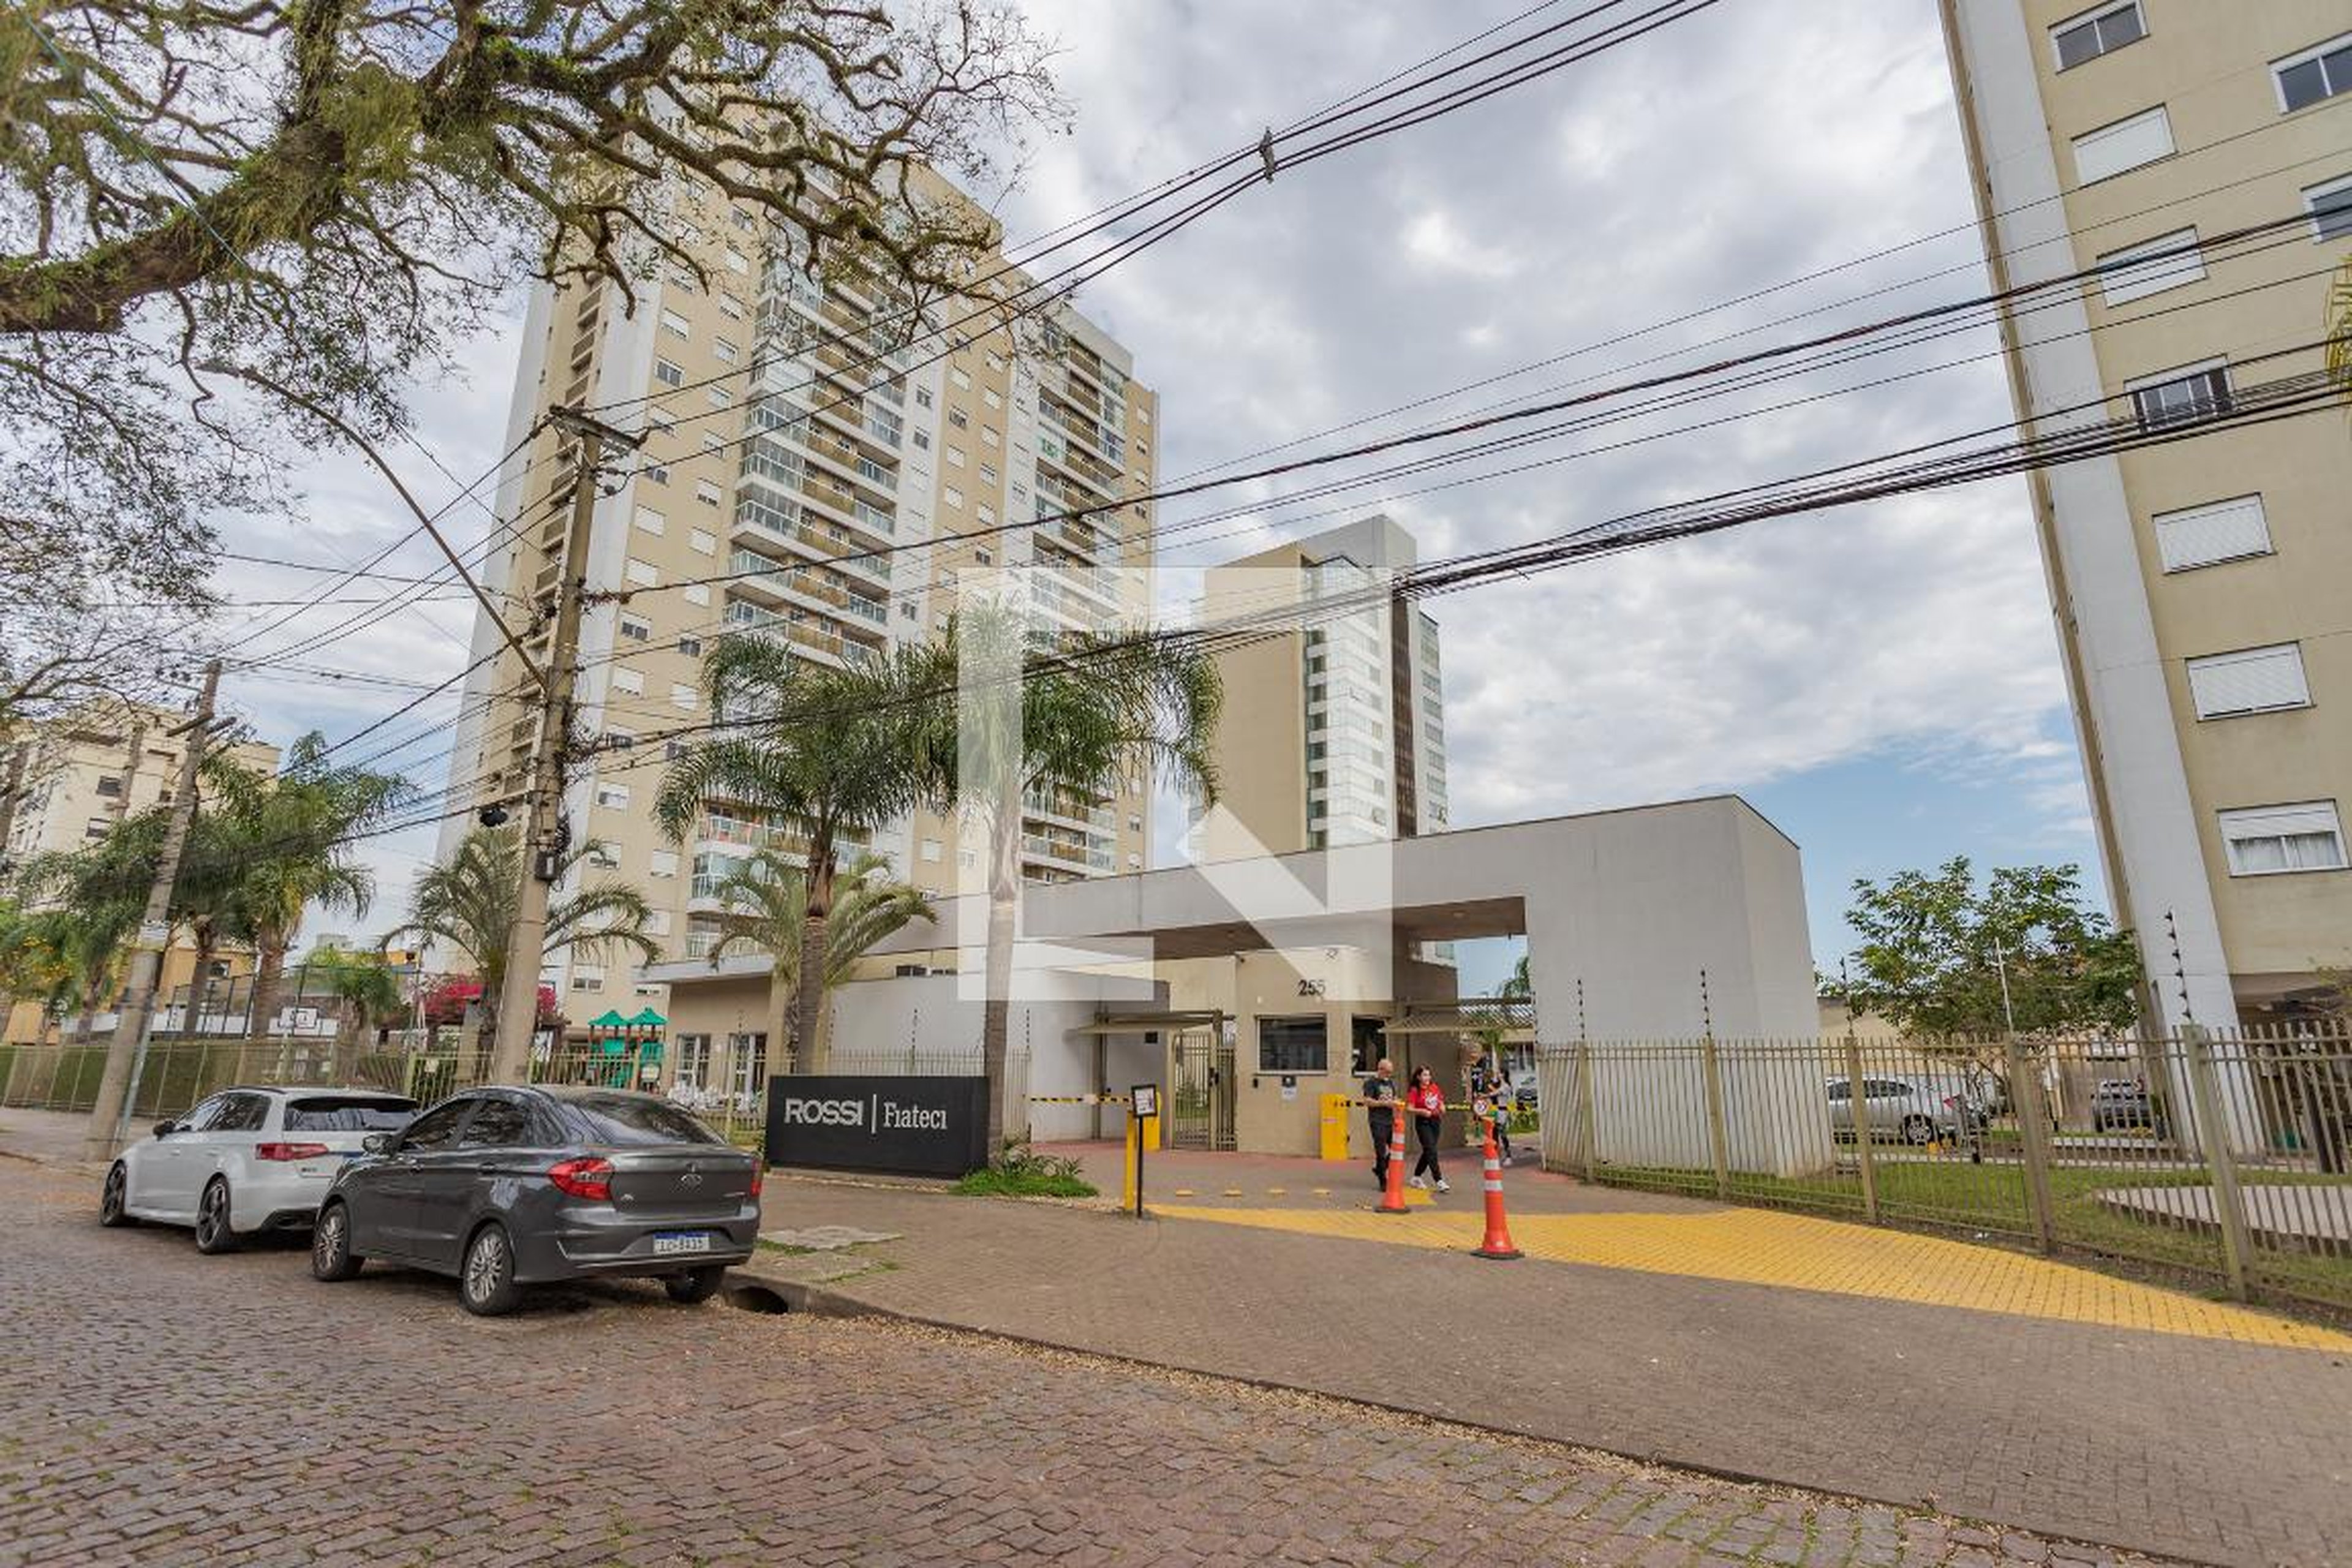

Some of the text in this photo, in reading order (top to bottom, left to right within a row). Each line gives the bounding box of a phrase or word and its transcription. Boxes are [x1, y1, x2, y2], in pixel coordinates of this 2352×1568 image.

[1298, 979, 1325, 996] 255
[785, 1099, 947, 1129] ROSSI Fiateci
